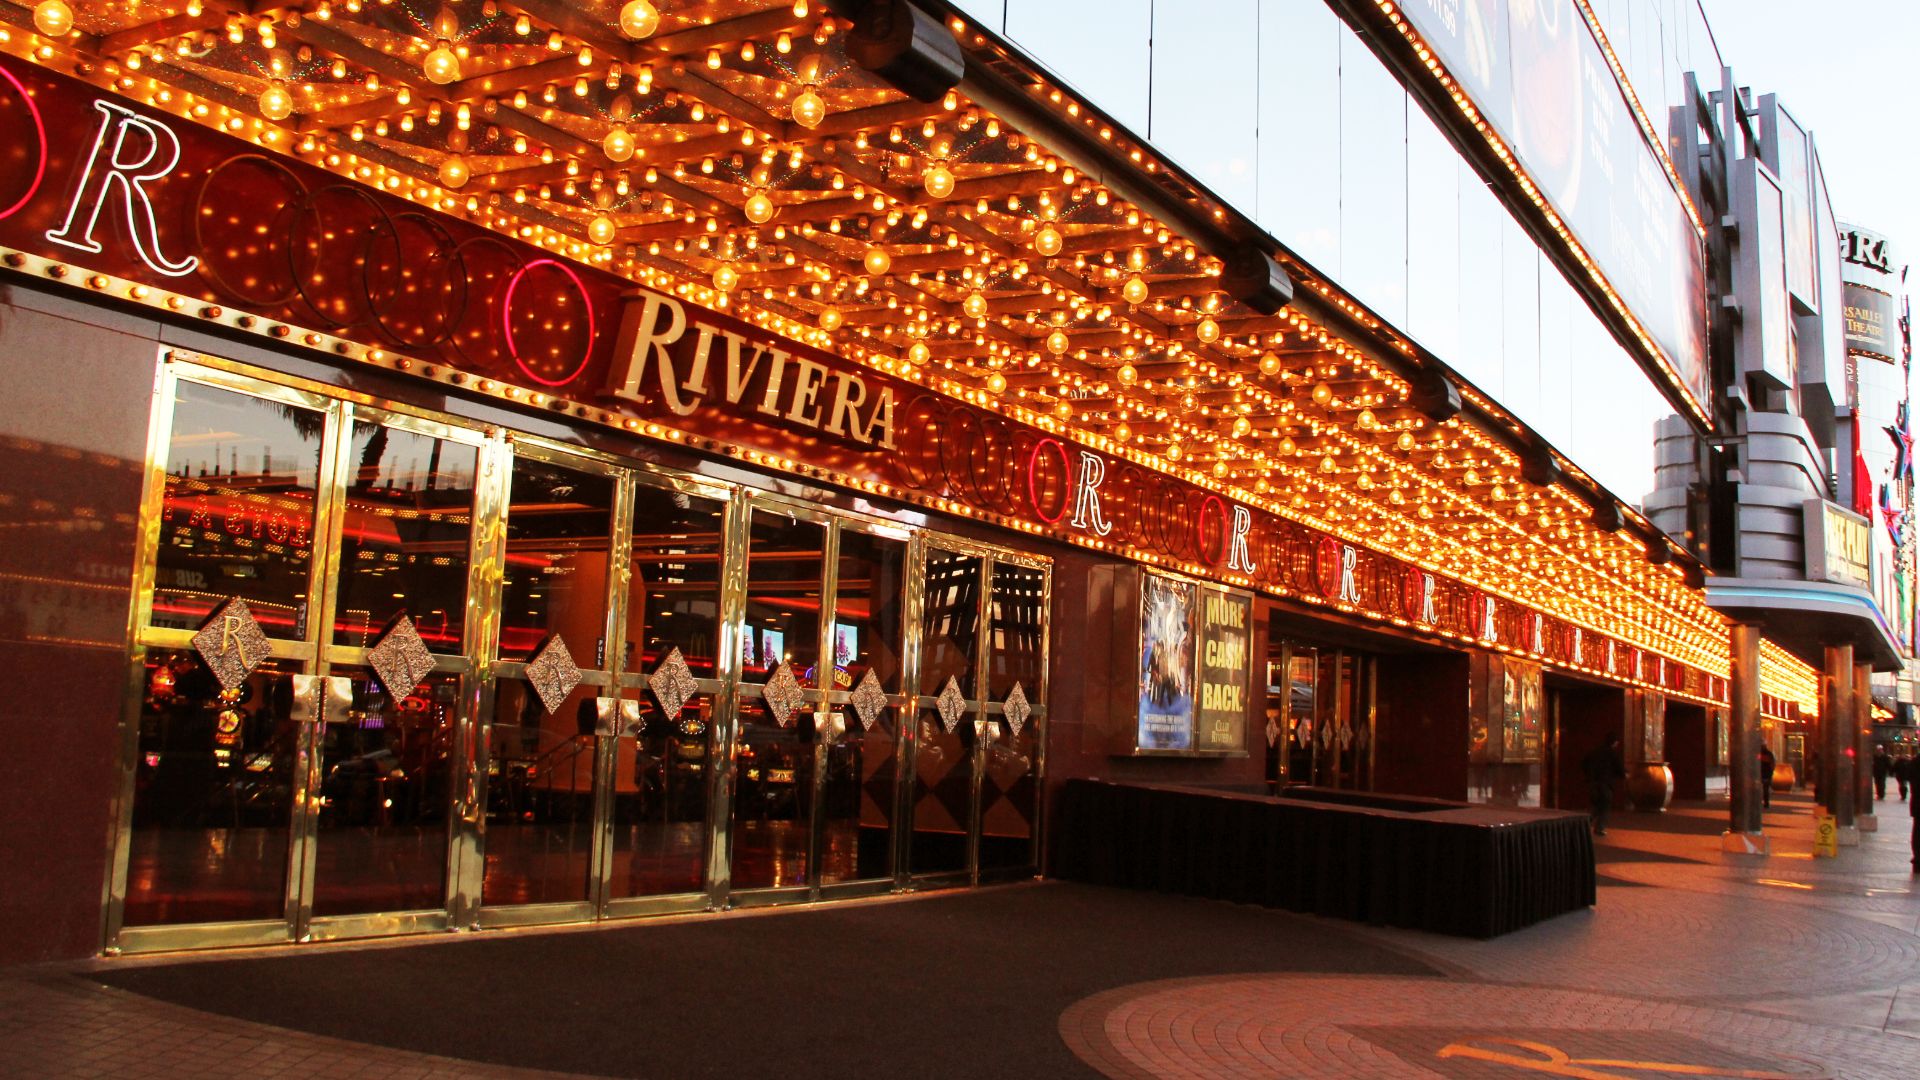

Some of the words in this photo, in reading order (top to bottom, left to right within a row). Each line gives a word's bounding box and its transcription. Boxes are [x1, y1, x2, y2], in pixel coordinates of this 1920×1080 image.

[613, 287, 898, 450] RIVIERA
[1206, 596, 1245, 629] MORE
[1205, 639, 1243, 671] CASH
[1202, 682, 1243, 712] BACK.
